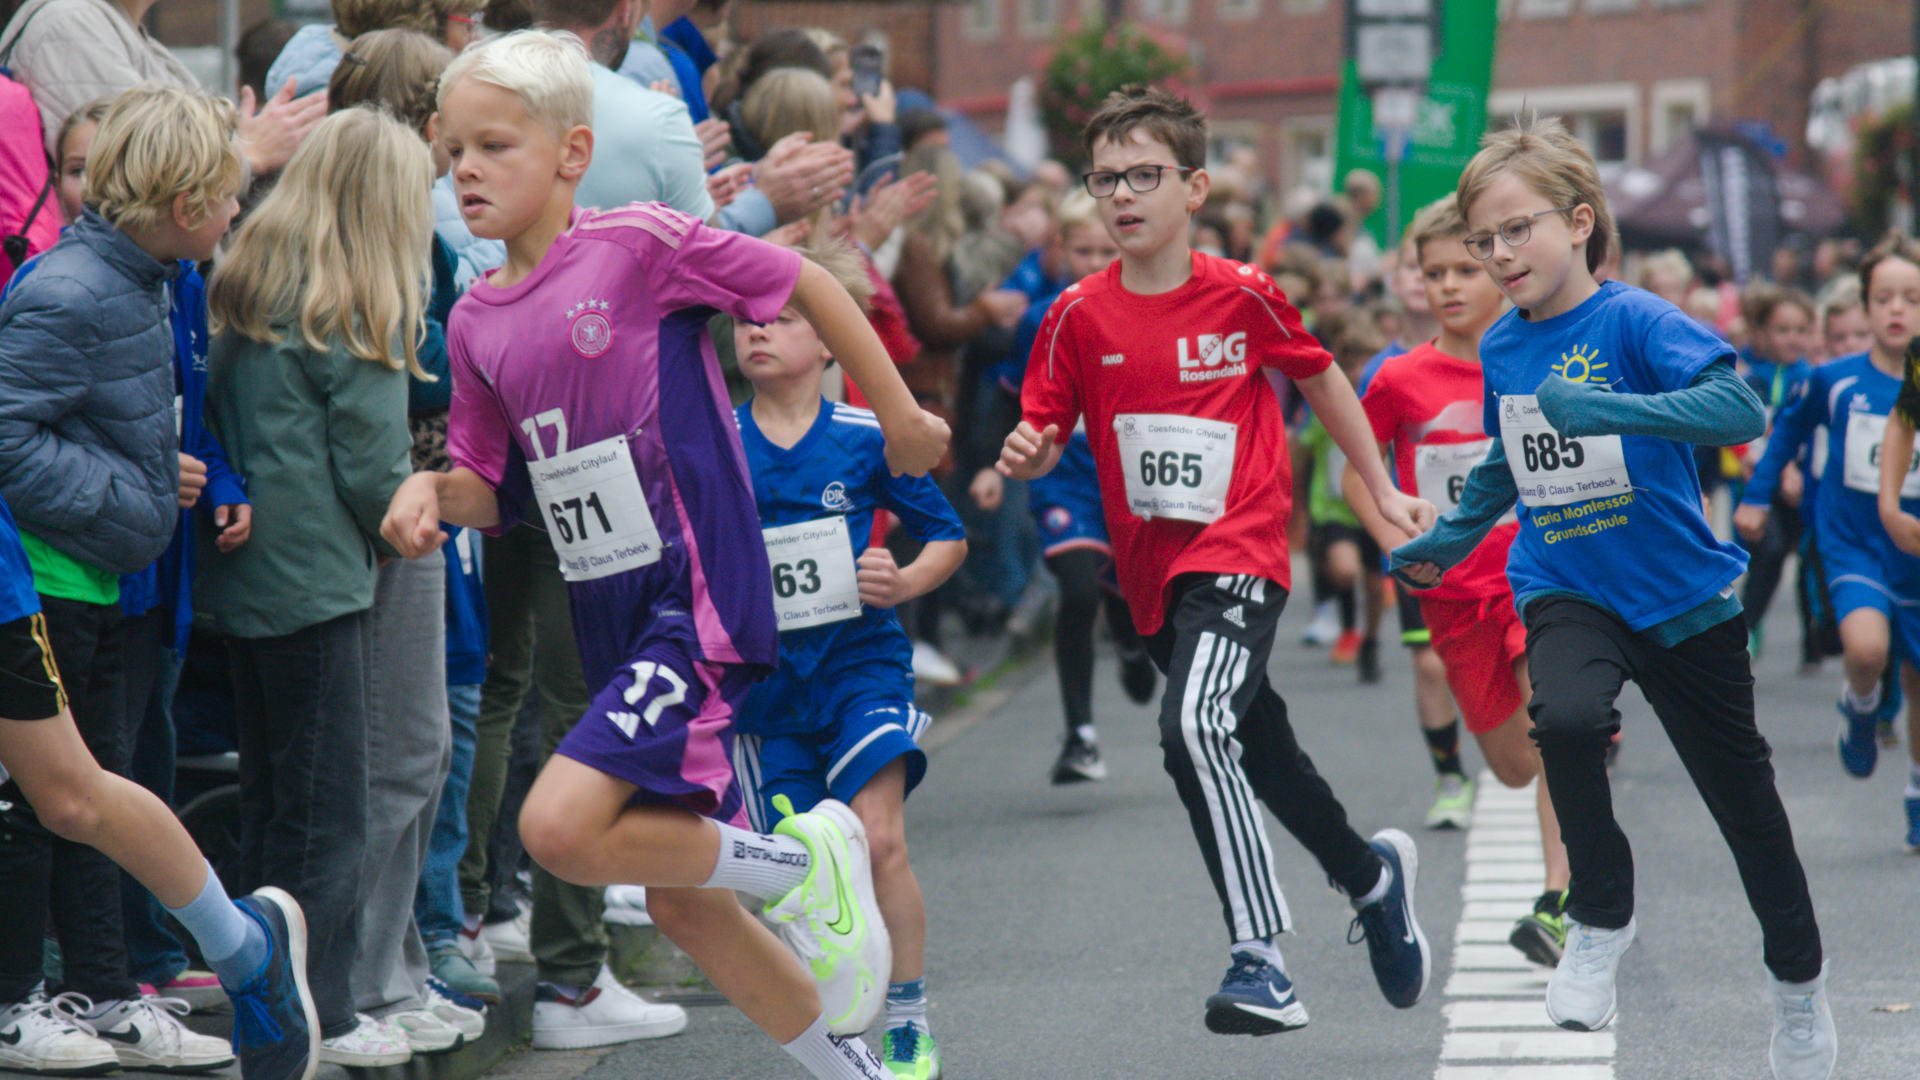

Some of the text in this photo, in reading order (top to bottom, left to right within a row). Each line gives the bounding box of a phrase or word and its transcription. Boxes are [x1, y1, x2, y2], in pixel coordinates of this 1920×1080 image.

[1101, 353, 1124, 366] JAKO
[1179, 362, 1248, 383] Rosendahl
[519, 407, 569, 461] 17
[1148, 424, 1228, 441] Coesfelder Citylauf
[580, 449, 618, 470] Citylauf
[1521, 432, 1585, 473] 685
[1139, 449, 1203, 489] 665
[1548, 484, 1575, 496] Claus
[1576, 476, 1617, 492] Terbeck
[549, 490, 613, 545] 671
[1543, 513, 1629, 545] Grundschule
[589, 553, 614, 568] Claus
[613, 540, 651, 560] Terbeck
[771, 557, 822, 599] 63
[783, 600, 849, 621] Claus Terbeck
[623, 660, 689, 727] 17
